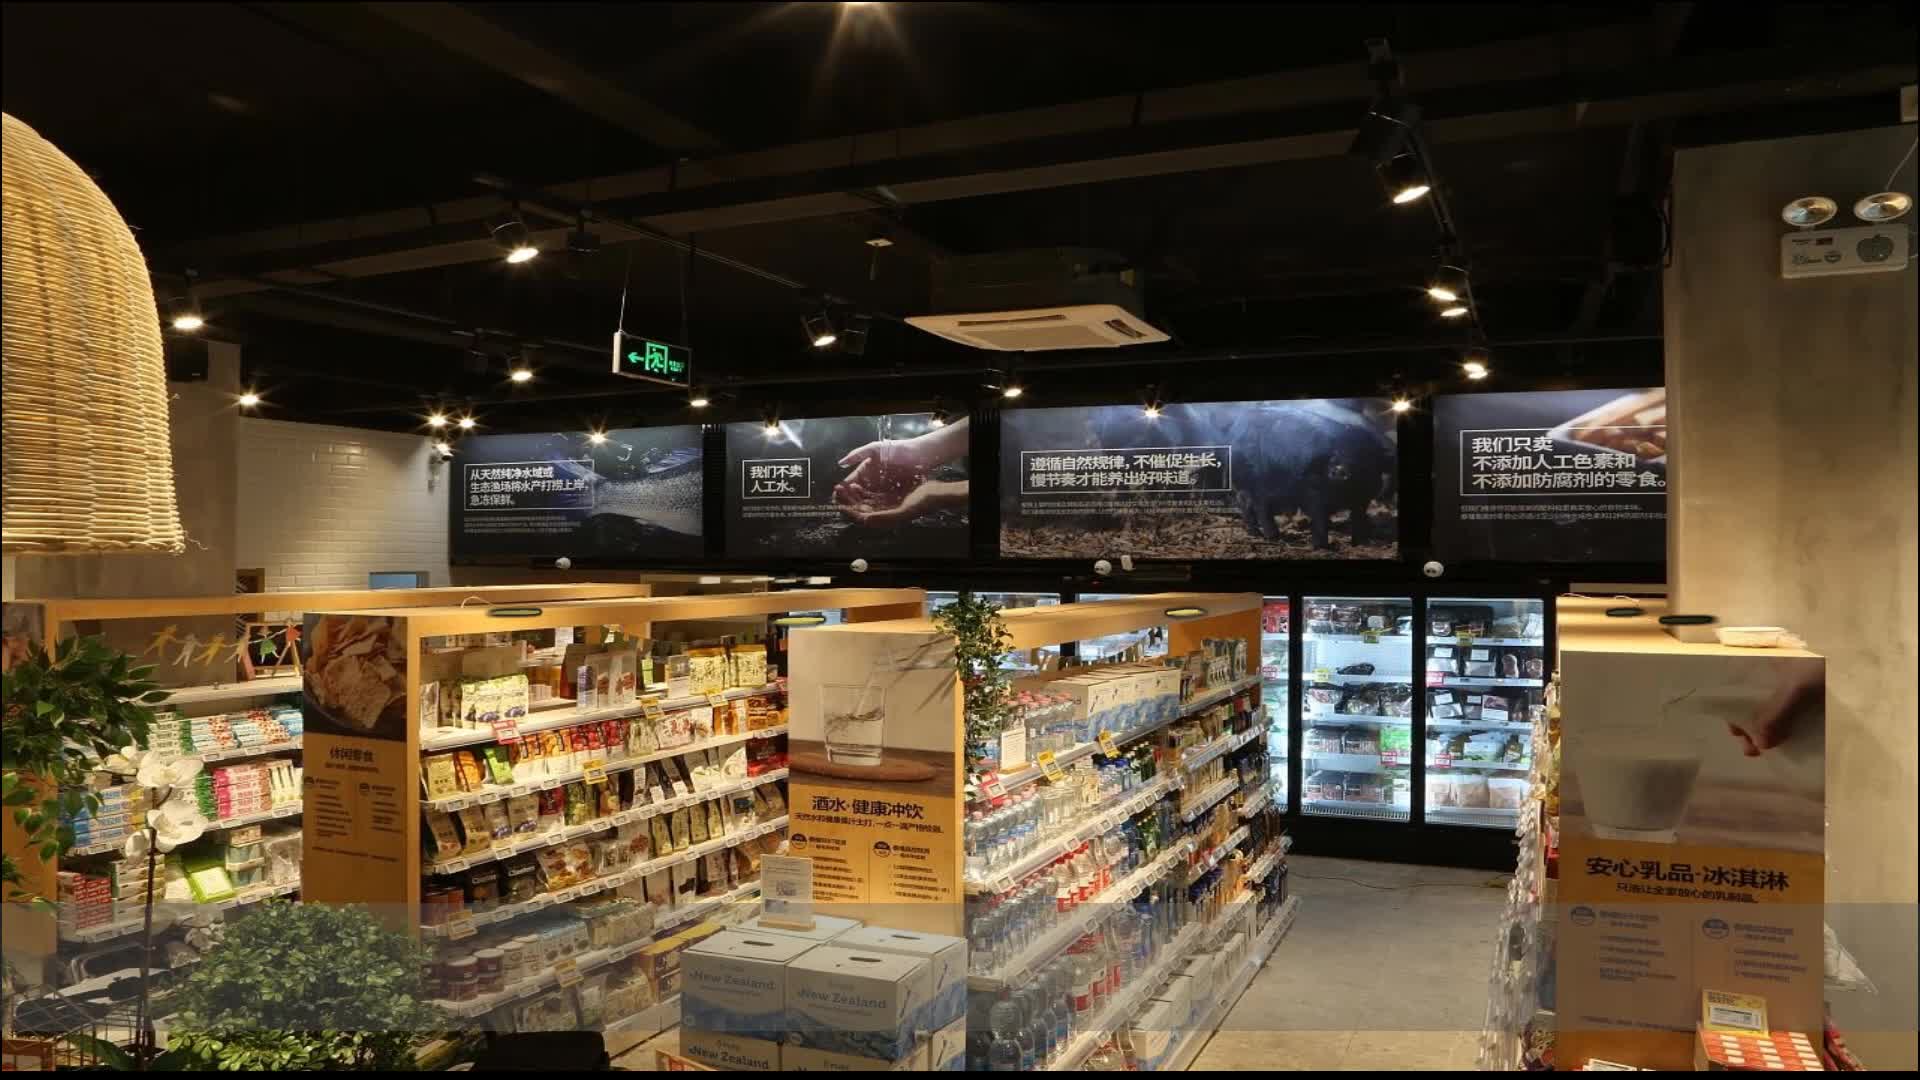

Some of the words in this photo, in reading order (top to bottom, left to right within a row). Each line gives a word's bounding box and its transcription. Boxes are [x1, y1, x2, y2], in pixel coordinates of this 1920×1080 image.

[1472, 436, 1553, 453] 我们只卖
[1472, 453, 1636, 471] 不添加人工色素和
[470, 466, 554, 480] 从天然纯净水域或
[750, 465, 803, 479] 我们不卖
[1029, 470, 1198, 487] 慢节奏才能养出好味道。
[1472, 471, 1666, 489] 不添加防腐剂的零食。
[751, 480, 796, 493] 人工水。
[689, 968, 720, 983] New
[725, 973, 776, 991] Zealand
[798, 986, 830, 1002] New
[832, 992, 887, 1009] Zealand
[688, 1045, 718, 1060] New
[720, 1051, 769, 1070] Zealand
